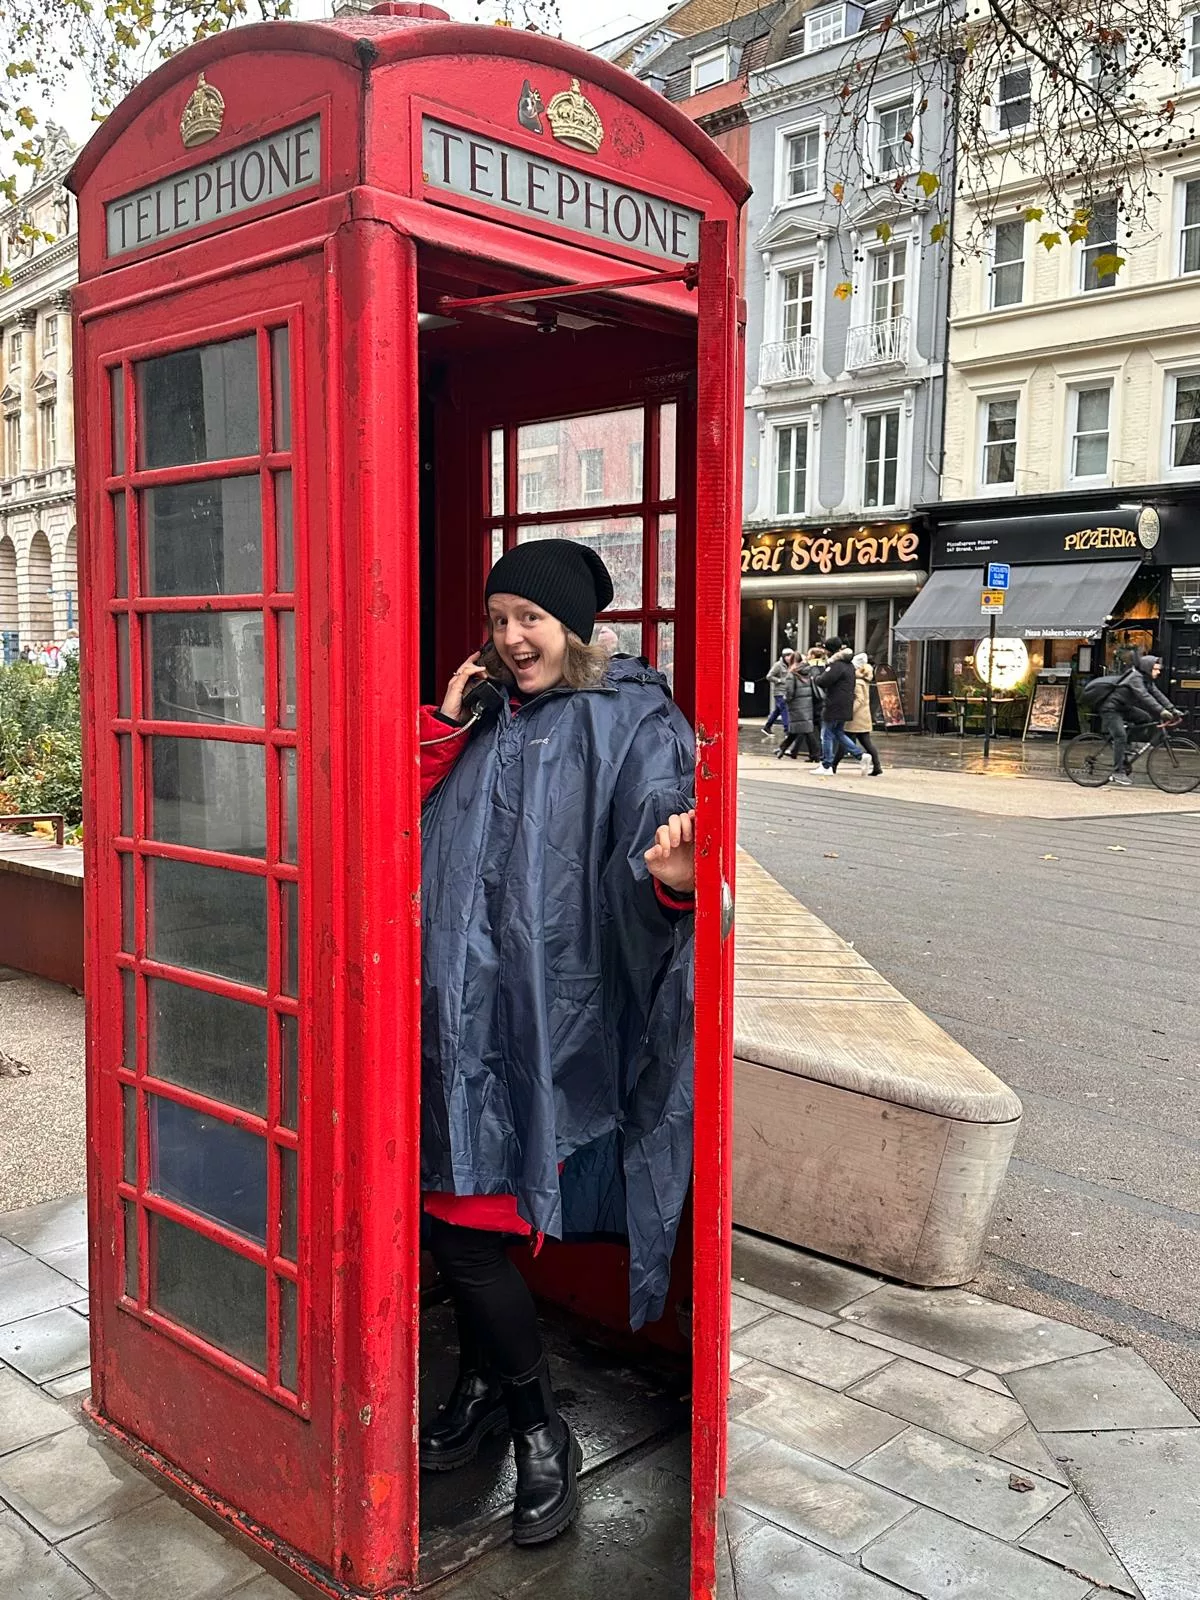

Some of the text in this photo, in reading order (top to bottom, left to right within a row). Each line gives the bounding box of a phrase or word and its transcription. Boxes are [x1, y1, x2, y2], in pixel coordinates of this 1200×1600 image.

[113, 129, 314, 247] TELEPHONE
[429, 129, 693, 257] TELEPHONE
[741, 533, 920, 573] hai Square
[1064, 527, 1137, 550] PIZZERIA
[1041, 629, 1065, 637] Makers
[1065, 629, 1082, 637] Since
